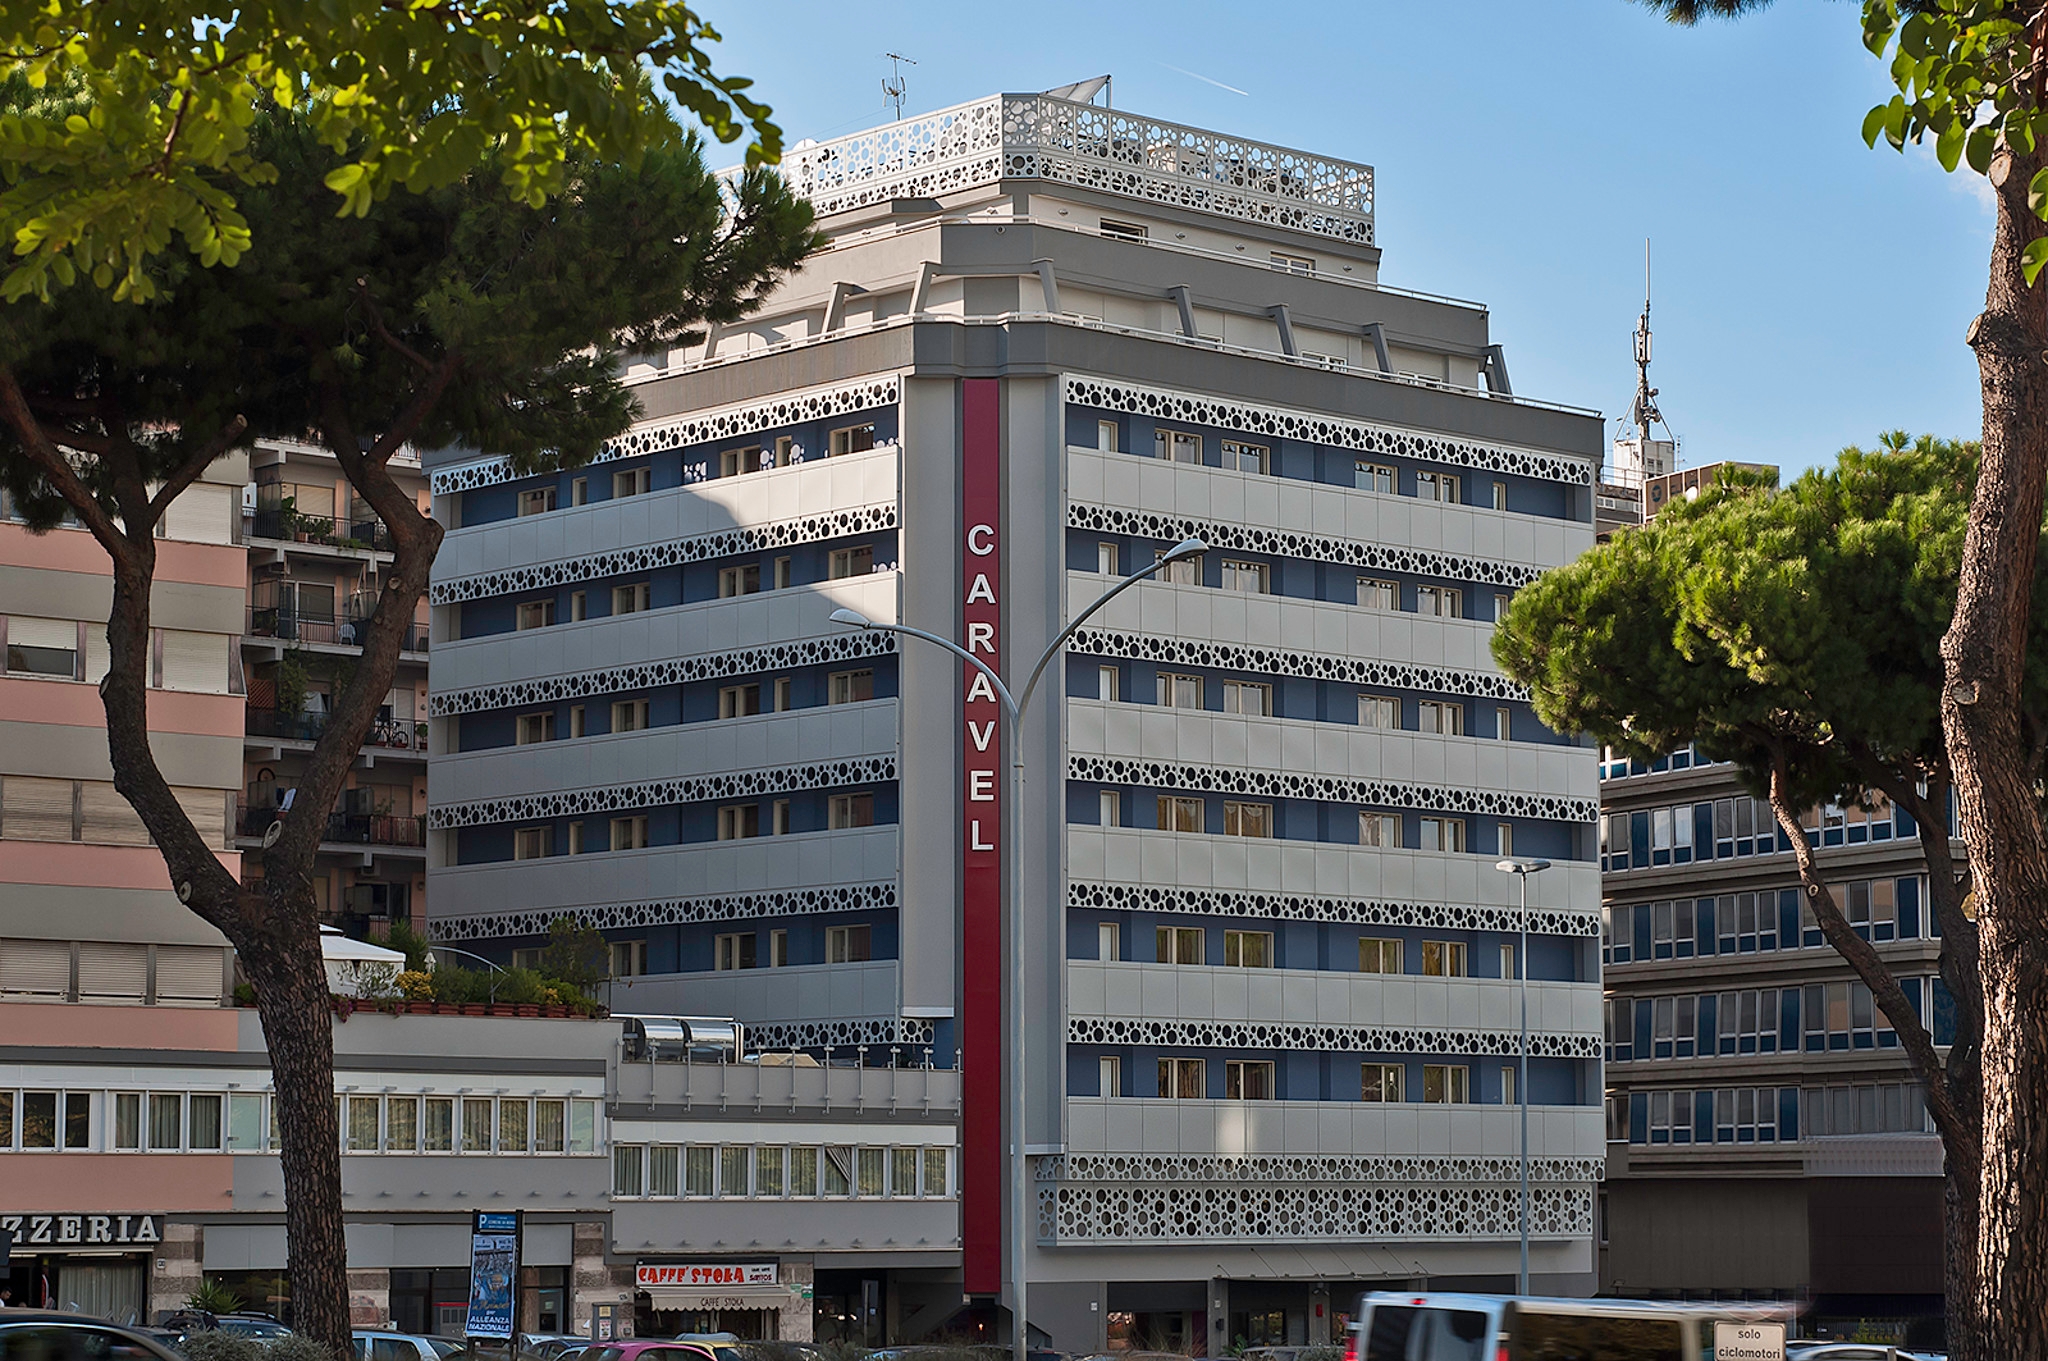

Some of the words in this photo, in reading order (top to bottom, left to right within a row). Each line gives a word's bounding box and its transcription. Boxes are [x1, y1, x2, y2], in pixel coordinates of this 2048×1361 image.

[966, 524, 997, 851] CARAVEL
[470, 1315, 510, 1325] ALLEANZA
[468, 1323, 510, 1332] NAZIONALE
[1737, 1328, 1761, 1339] solo
[1718, 1346, 1780, 1359] ciclomotori
